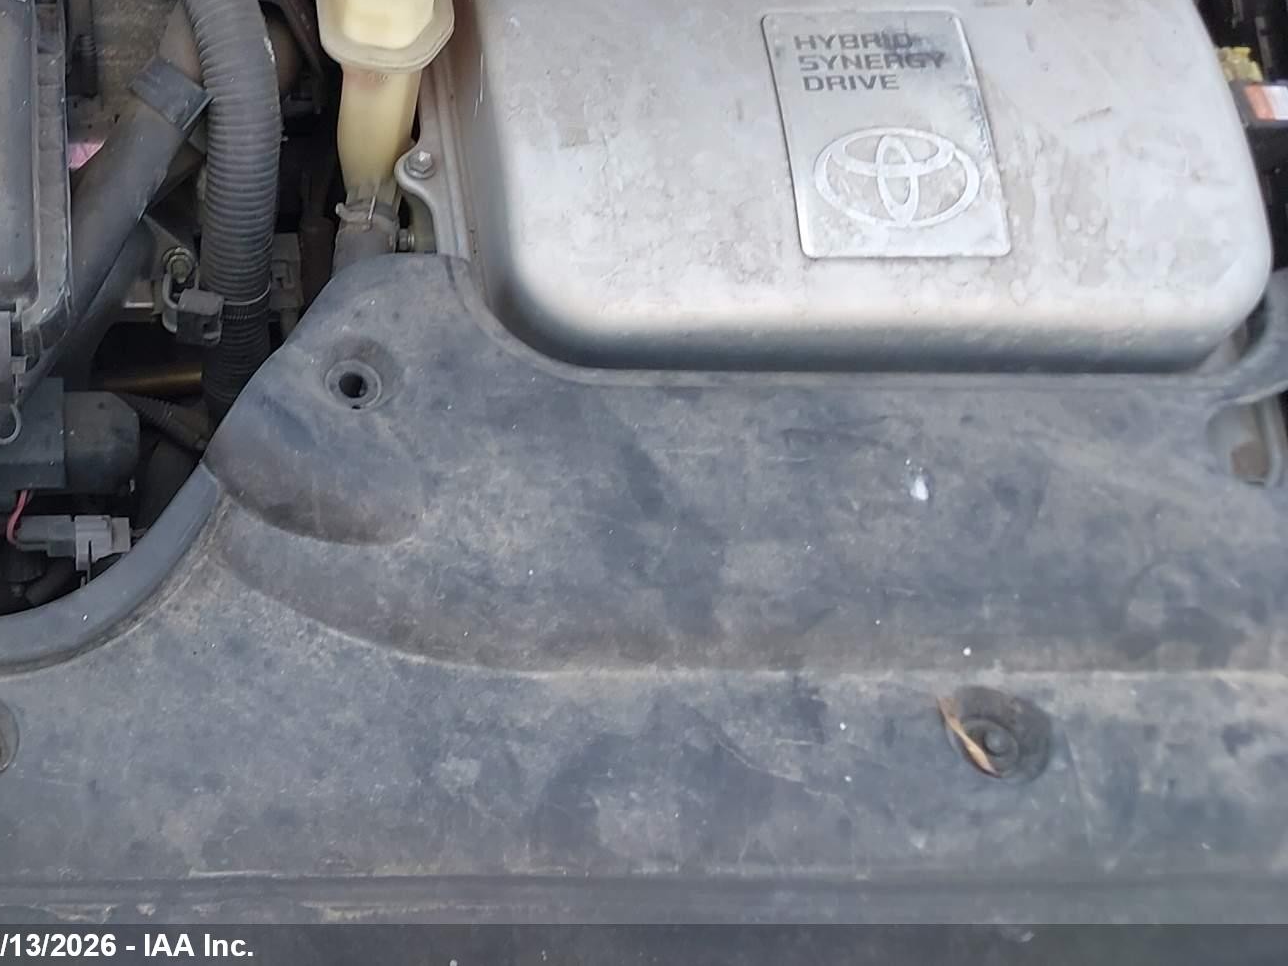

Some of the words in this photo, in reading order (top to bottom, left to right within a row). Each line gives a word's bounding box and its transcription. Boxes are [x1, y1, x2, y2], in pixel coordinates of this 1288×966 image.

[793, 32, 914, 51] HYBRID
[799, 52, 946, 71] SYNERGY
[803, 74, 900, 91] DRIVE
